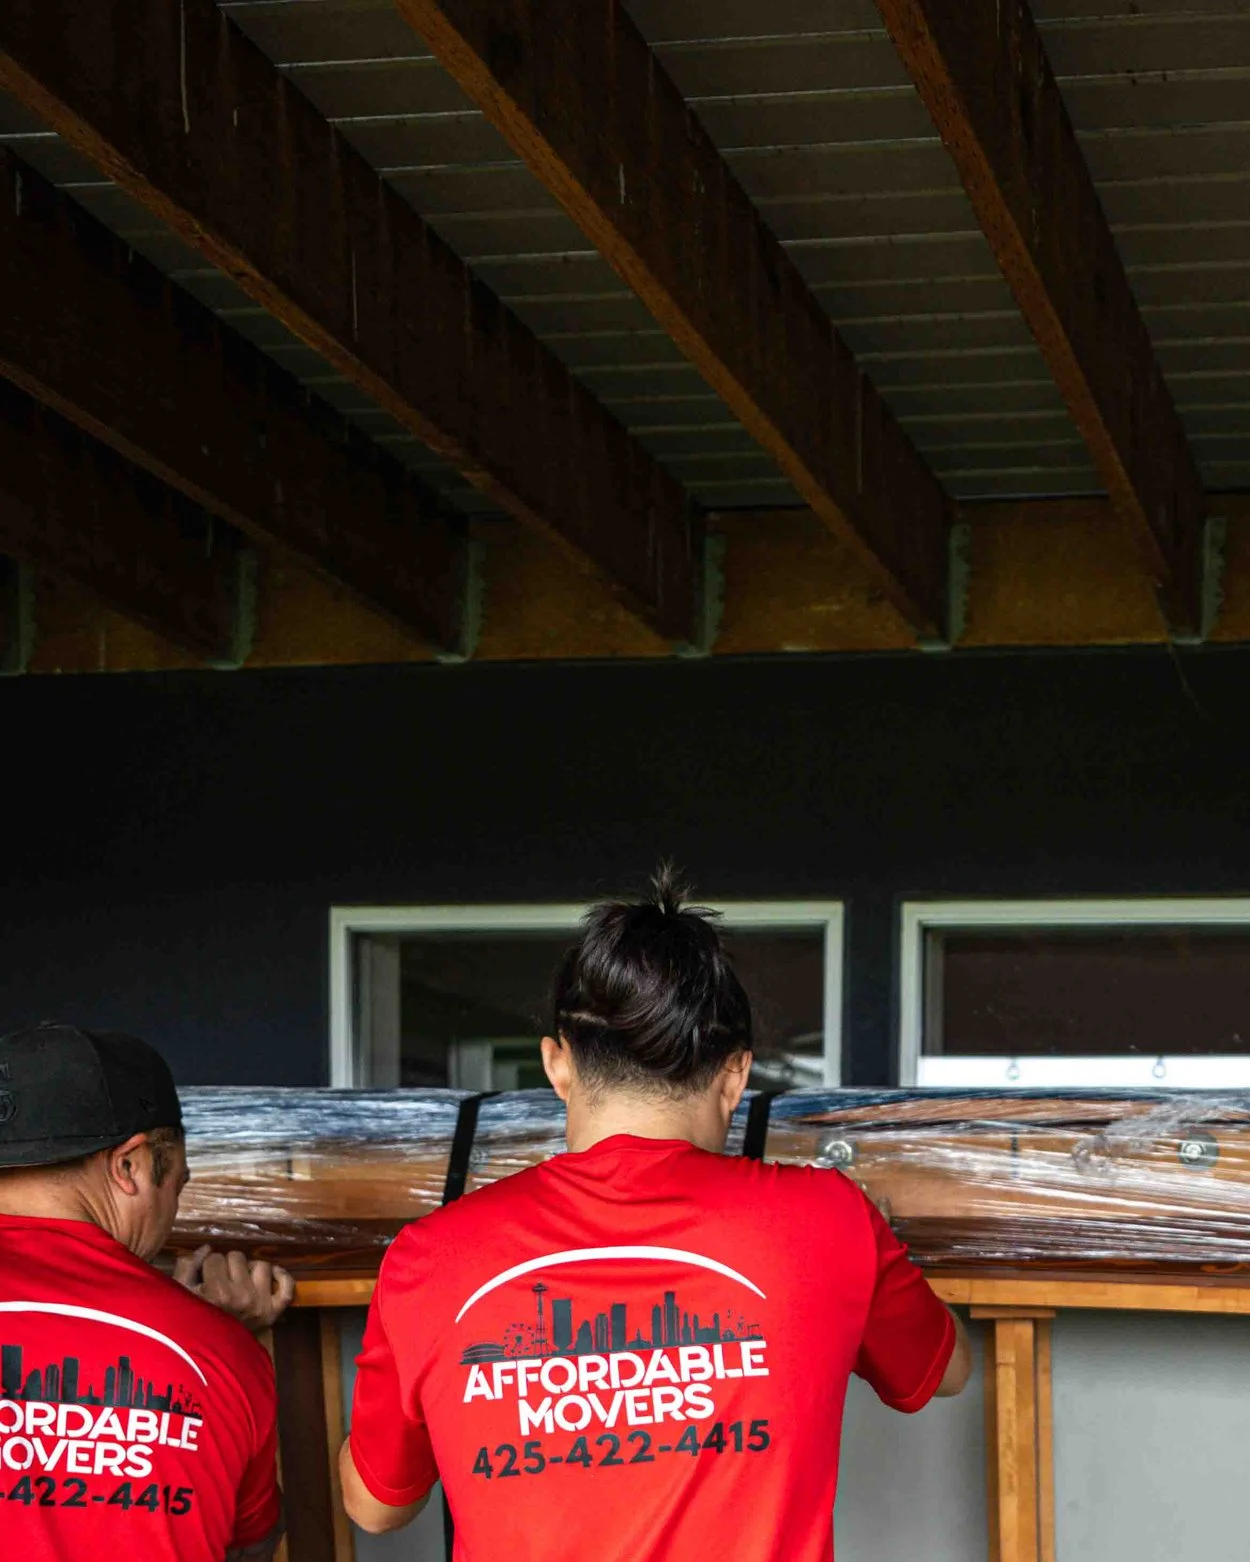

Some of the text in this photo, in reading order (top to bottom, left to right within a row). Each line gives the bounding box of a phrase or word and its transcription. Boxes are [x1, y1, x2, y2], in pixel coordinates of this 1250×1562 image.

[463, 1341, 769, 1403] AFFORDABLE
[518, 1384, 715, 1436] MOVERS
[0, 1436, 153, 1478] OVERS
[472, 1420, 771, 1479] 425-422-4415
